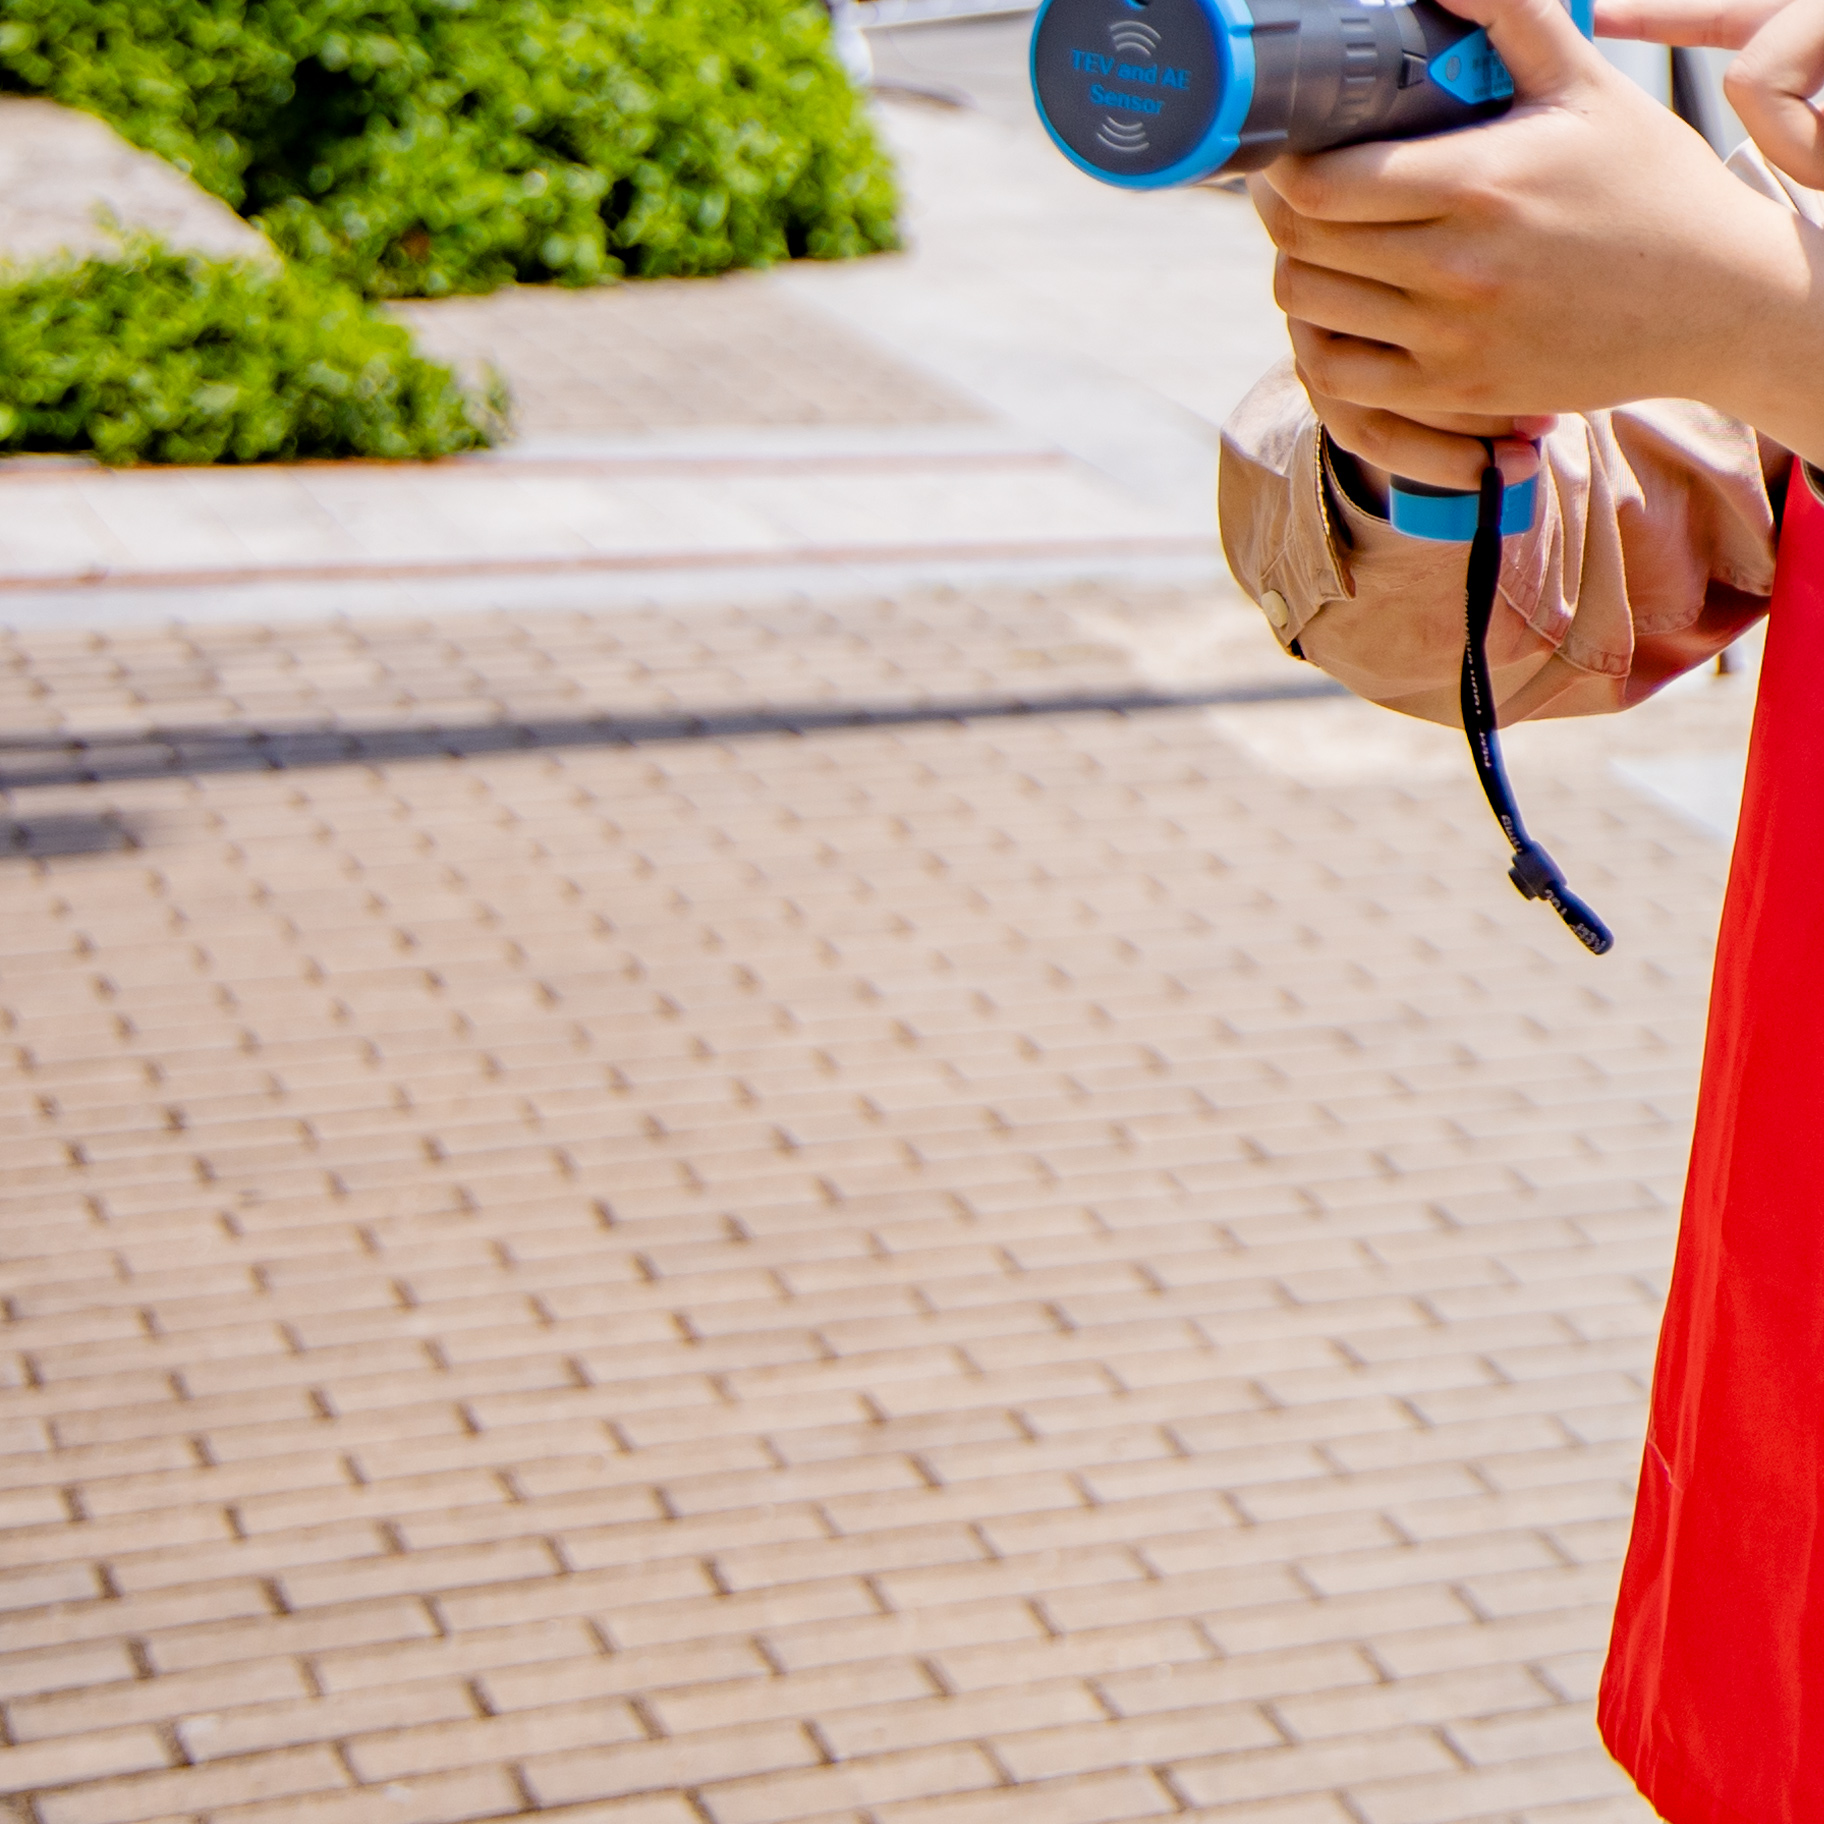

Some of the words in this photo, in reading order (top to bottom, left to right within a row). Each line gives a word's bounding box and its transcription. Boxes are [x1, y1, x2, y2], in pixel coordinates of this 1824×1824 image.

[1071, 48, 1115, 75] TEV
[1117, 63, 1158, 85] and
[1161, 66, 1191, 91] AE
[1089, 83, 1165, 114] Sensor
